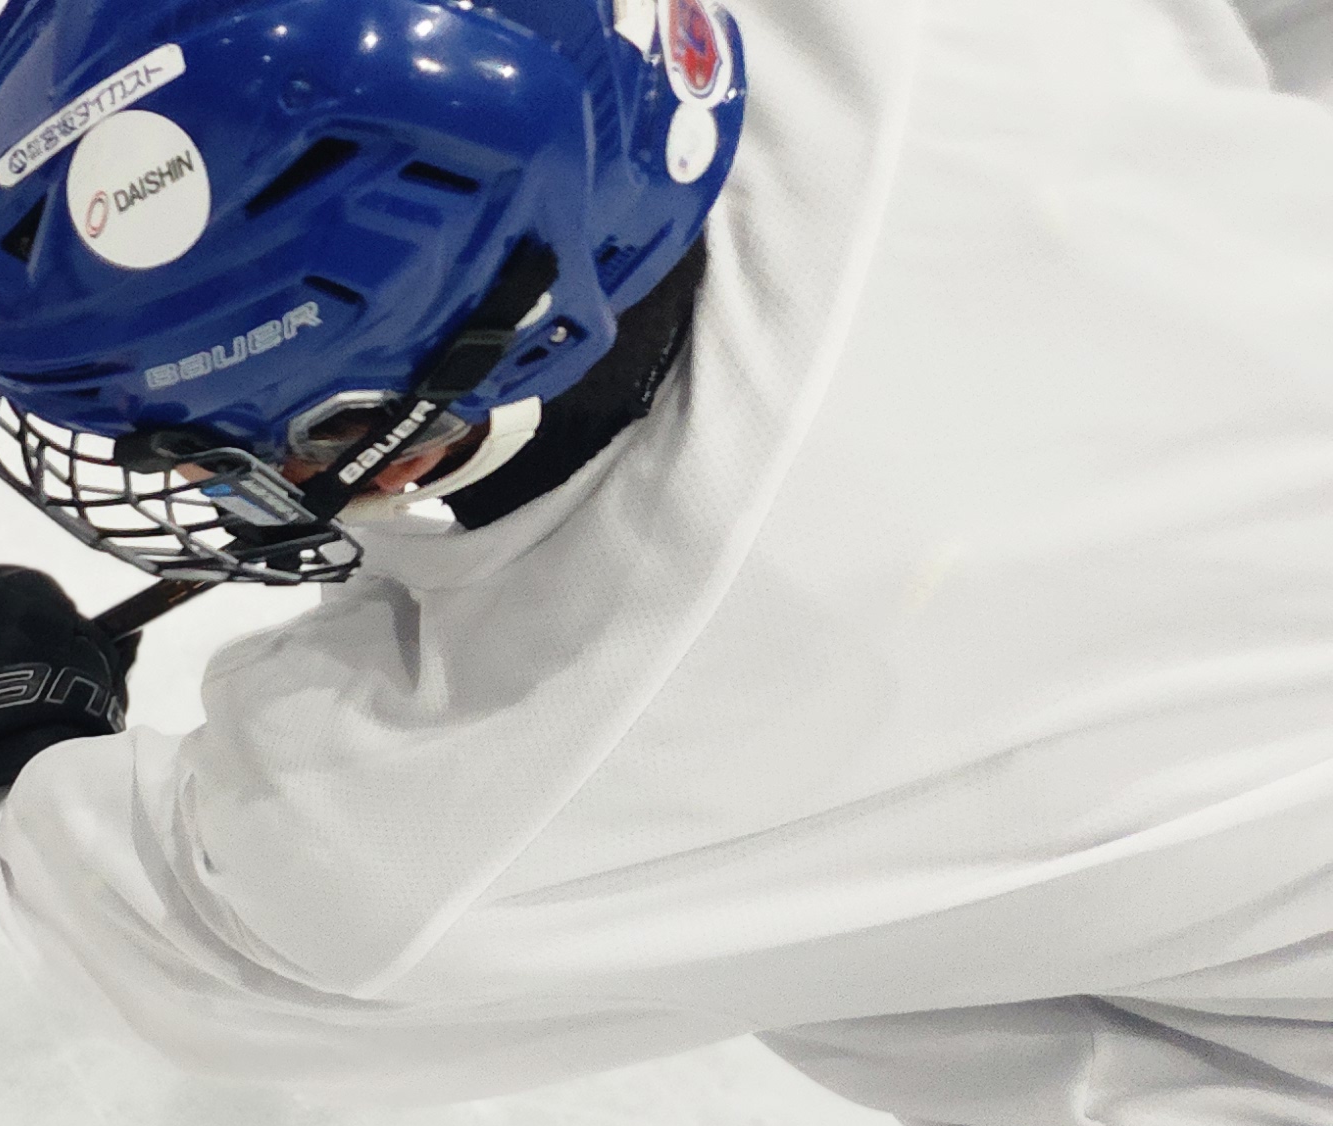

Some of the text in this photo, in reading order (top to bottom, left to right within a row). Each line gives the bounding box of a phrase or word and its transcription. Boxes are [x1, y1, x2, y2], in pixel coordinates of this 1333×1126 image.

[113, 149, 195, 213] DAISHIN
[144, 301, 323, 390] BAUER
[338, 400, 437, 485] BAUER
